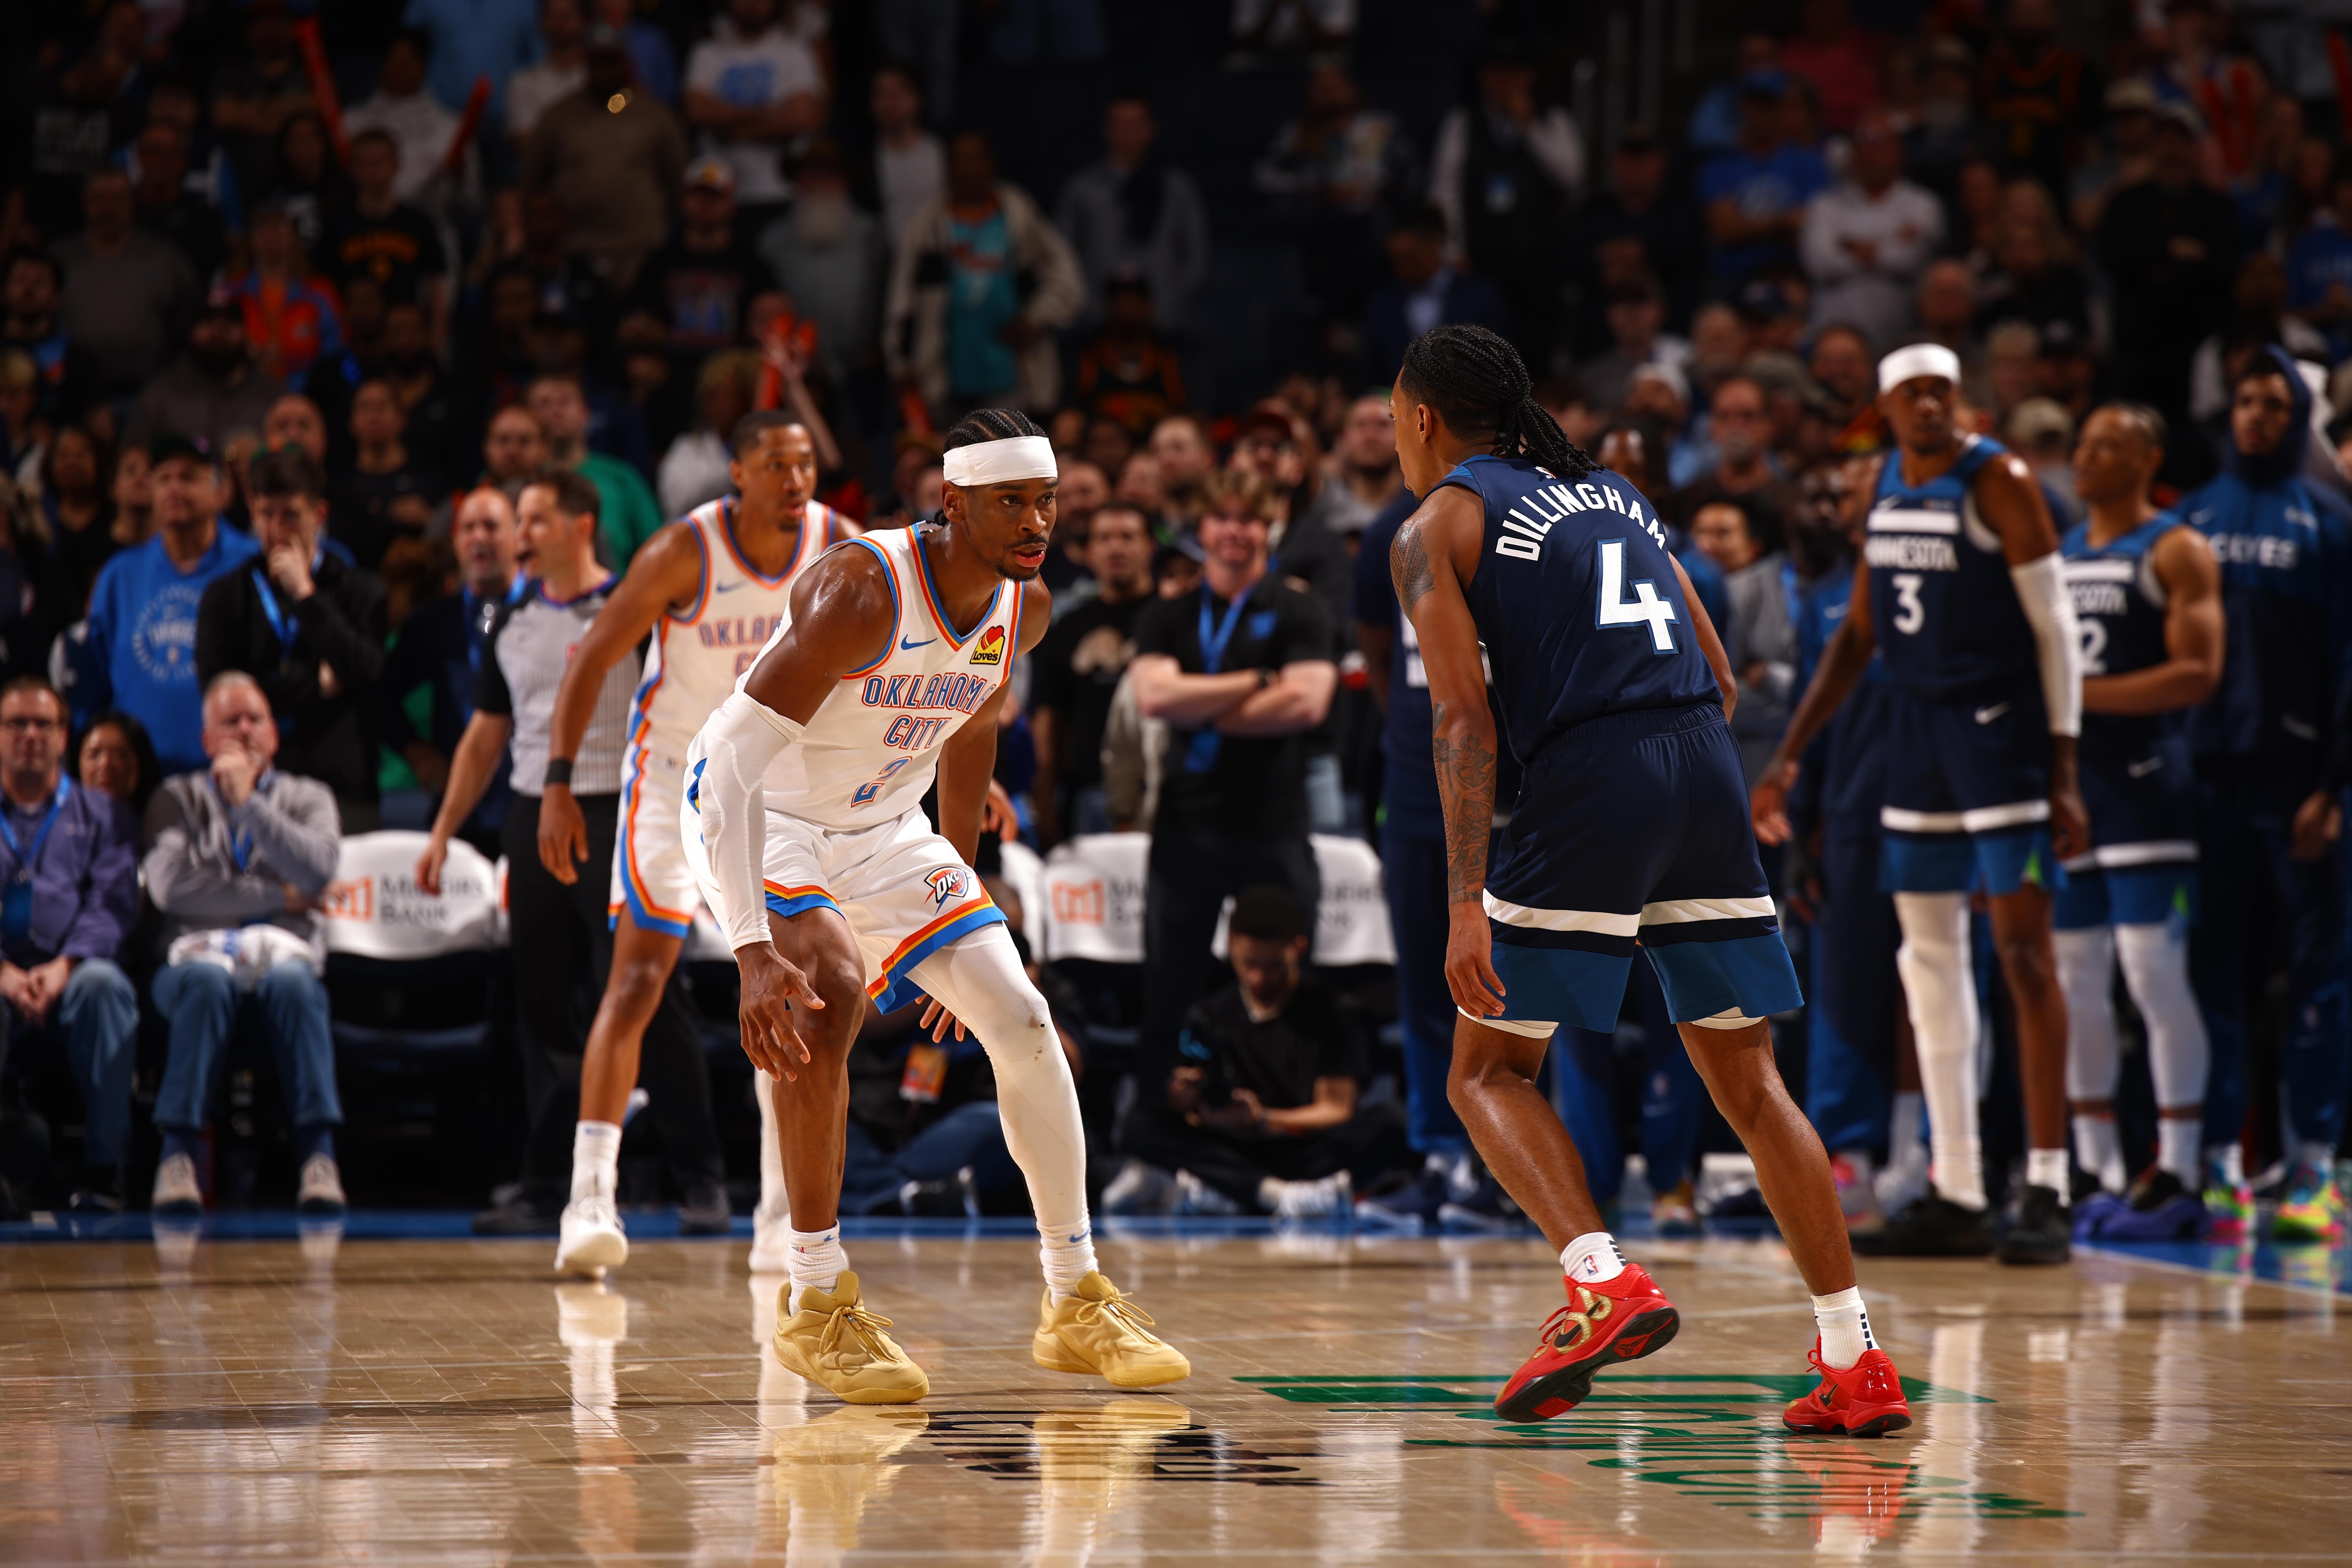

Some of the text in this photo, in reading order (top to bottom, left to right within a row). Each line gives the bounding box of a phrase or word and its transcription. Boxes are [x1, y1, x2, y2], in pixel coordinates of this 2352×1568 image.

[1495, 484, 1666, 561] DILLINGHAM
[1595, 538, 1680, 655] 4
[1891, 573, 1925, 635] 3
[883, 715, 953, 750] CITY
[850, 756, 913, 808] 2
[935, 870, 961, 902] OKC
